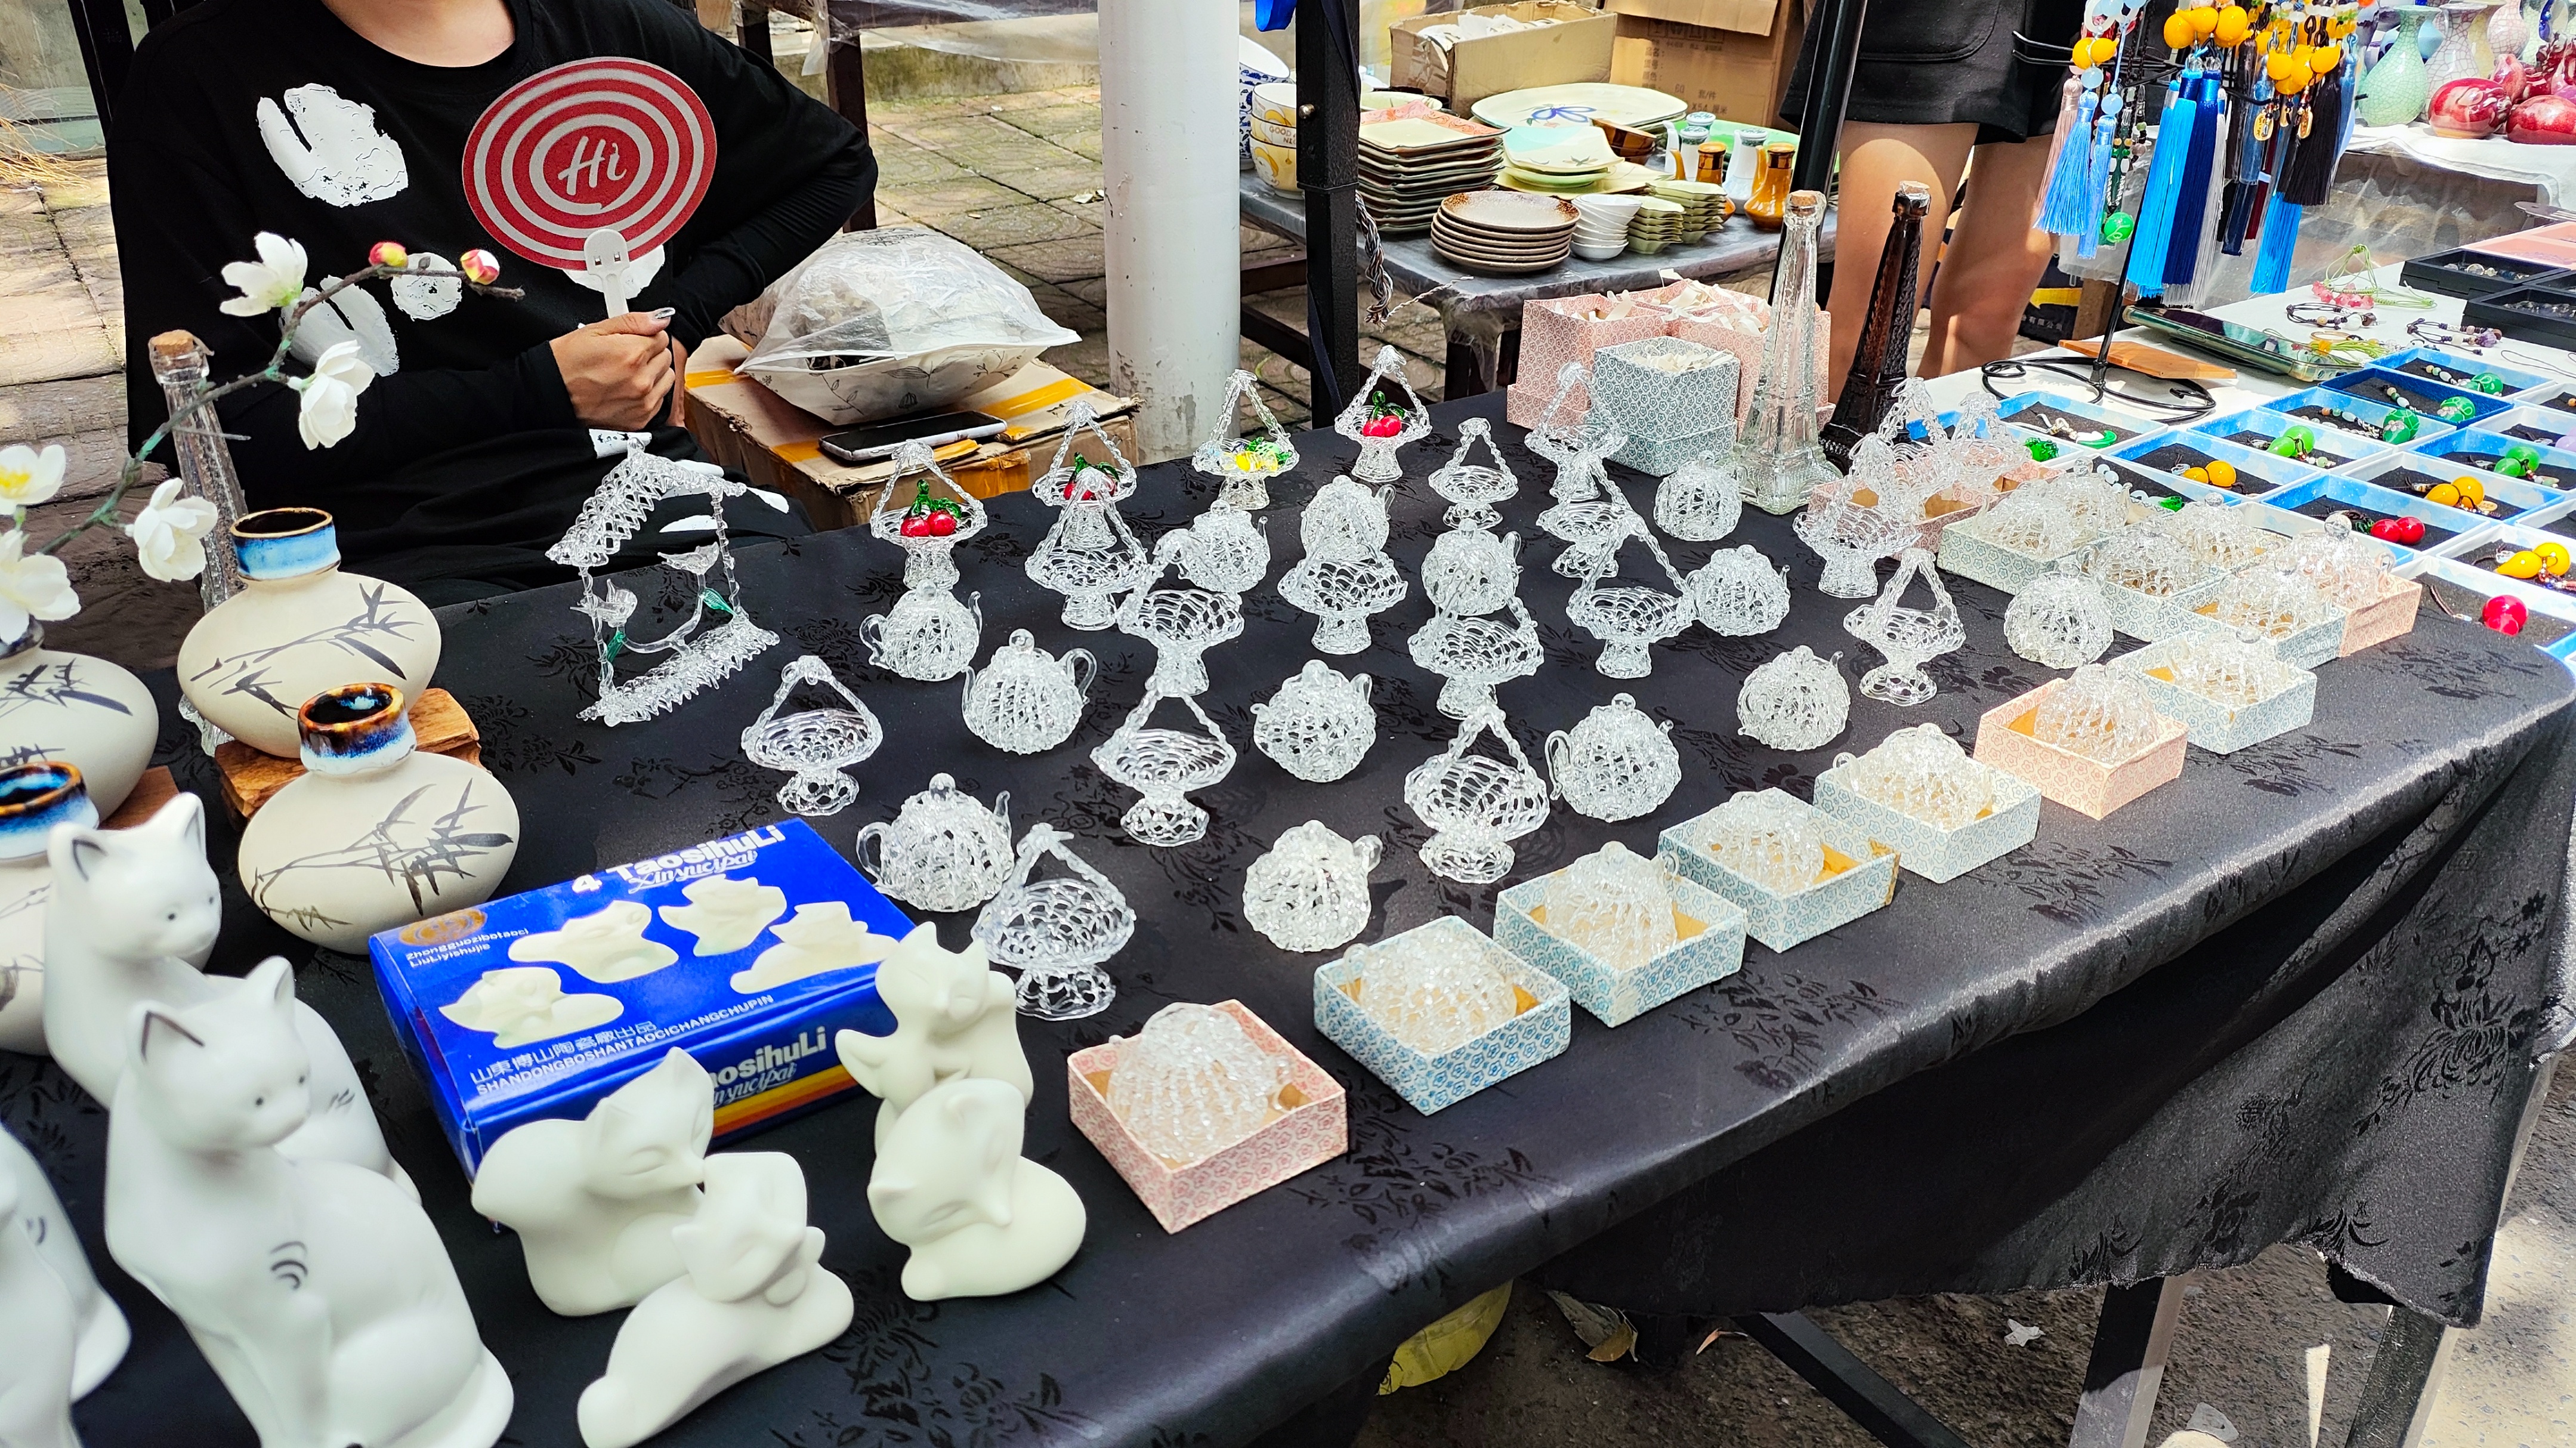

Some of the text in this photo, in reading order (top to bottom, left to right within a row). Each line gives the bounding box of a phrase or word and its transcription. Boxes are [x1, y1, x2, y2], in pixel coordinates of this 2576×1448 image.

[1269, 126, 1292, 137] GOOD
[558, 135, 627, 196] Hi
[572, 825, 786, 893] 4 TaosihuLi
